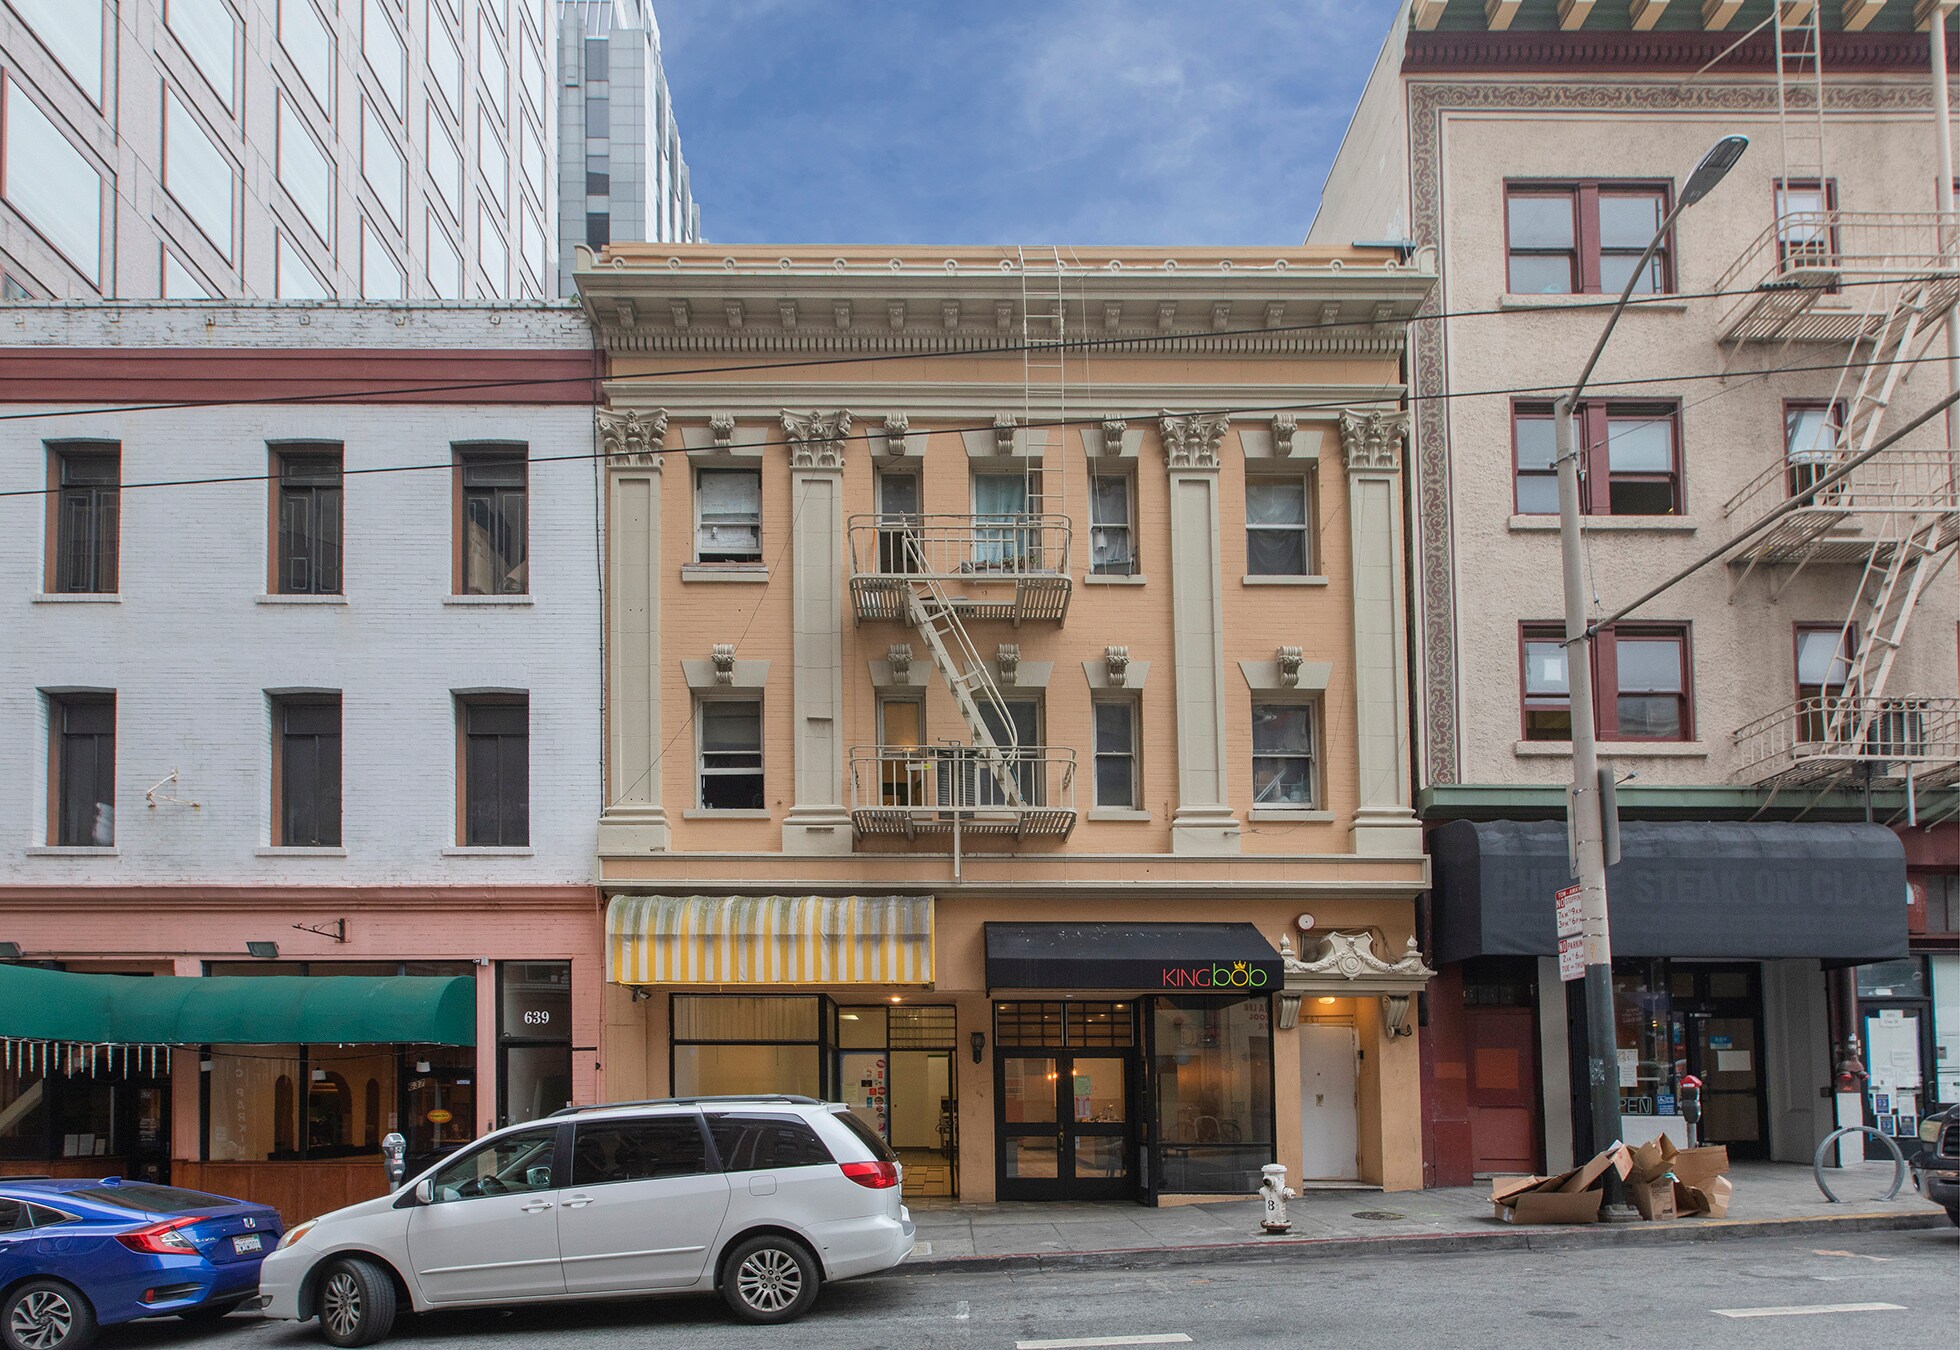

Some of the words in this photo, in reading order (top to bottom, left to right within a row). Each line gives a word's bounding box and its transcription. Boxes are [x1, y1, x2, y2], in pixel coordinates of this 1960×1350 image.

[1494, 868, 1621, 902] CHEE
[1633, 868, 1743, 903] STEAK
[1754, 868, 1799, 902] ON
[1811, 868, 1898, 903] CLAY
[1556, 898, 1565, 909] NO
[1565, 895, 1582, 905] STOPPIN
[1567, 940, 1583, 949] PARKIN
[524, 1010, 550, 1025] 639
[1620, 1098, 1650, 1114] PEN
[1267, 1200, 1275, 1211] 8
